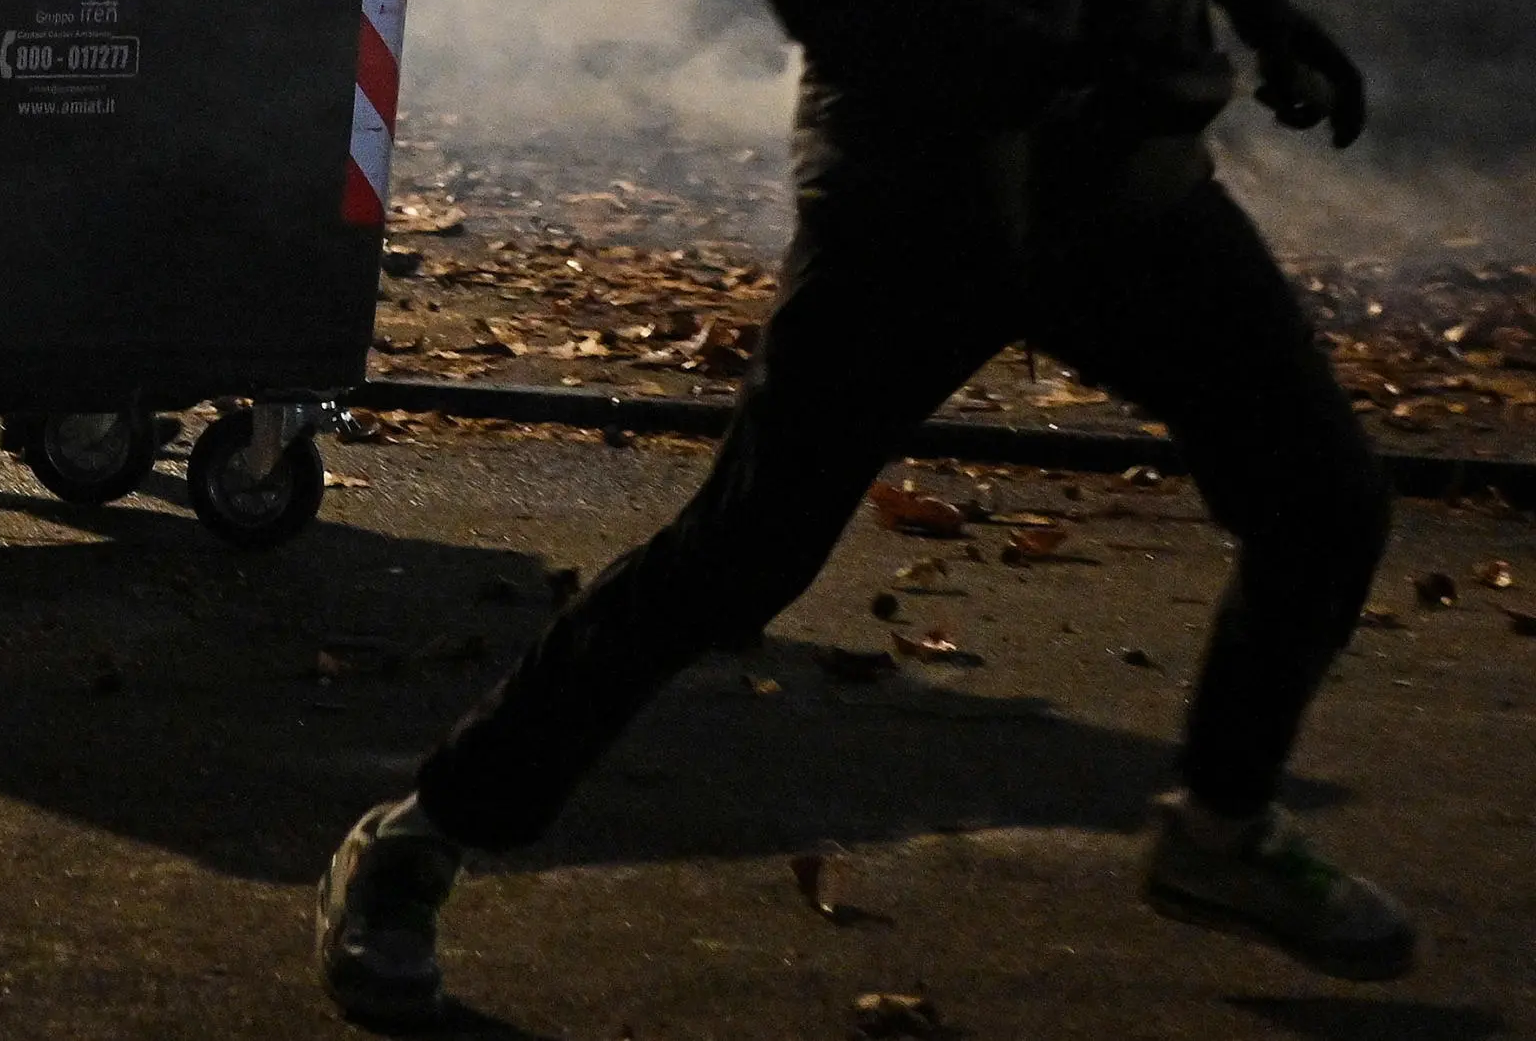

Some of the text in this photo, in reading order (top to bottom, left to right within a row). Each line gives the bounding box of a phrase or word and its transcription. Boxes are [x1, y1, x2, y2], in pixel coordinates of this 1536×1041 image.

[35, 10, 75, 26] Gruppo
[16, 45, 53, 71] 800
[67, 44, 129, 71] 017277
[18, 97, 117, 115] www.amiat.it
